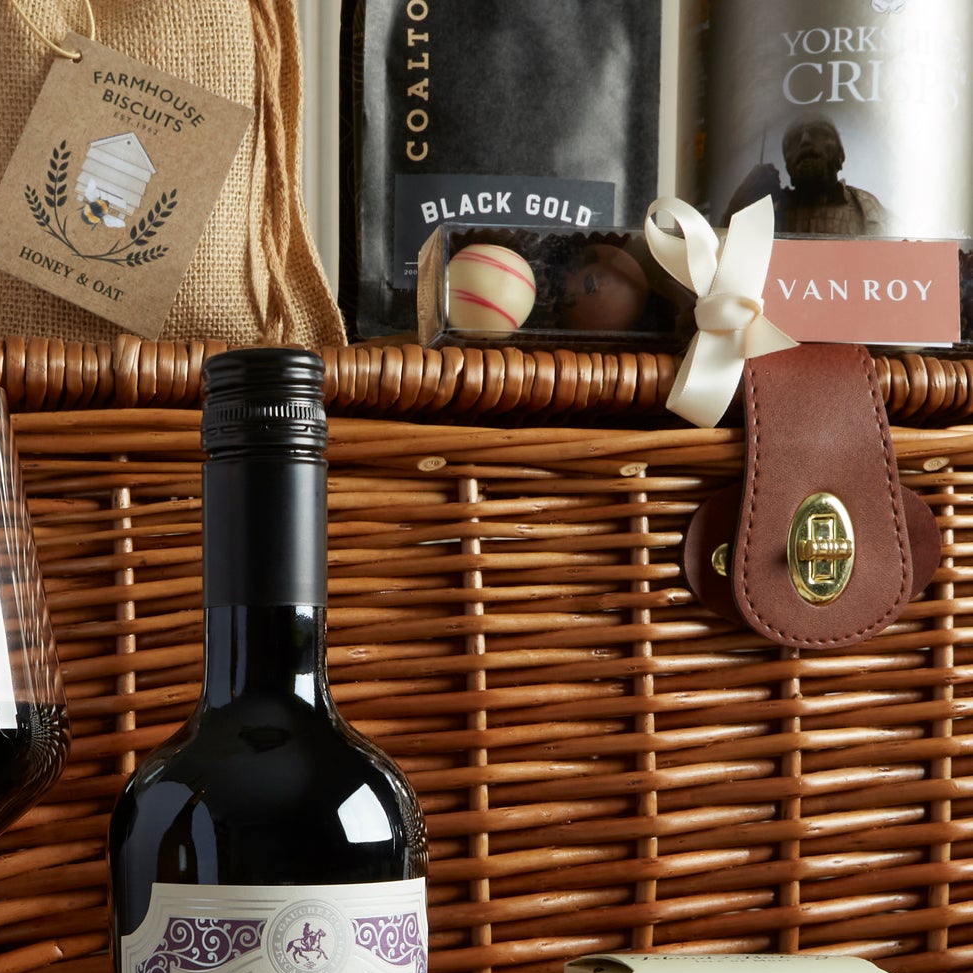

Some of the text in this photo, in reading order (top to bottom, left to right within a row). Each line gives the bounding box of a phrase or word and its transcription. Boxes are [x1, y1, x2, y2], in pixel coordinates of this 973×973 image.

[93, 71, 205, 128] FARMHOUSE
[102, 89, 184, 133] BISCUITS
[420, 191, 592, 226] BLACK GOLD
[19, 246, 124, 302] HONEY & OAT
[777, 279, 933, 301] VAN ROY
